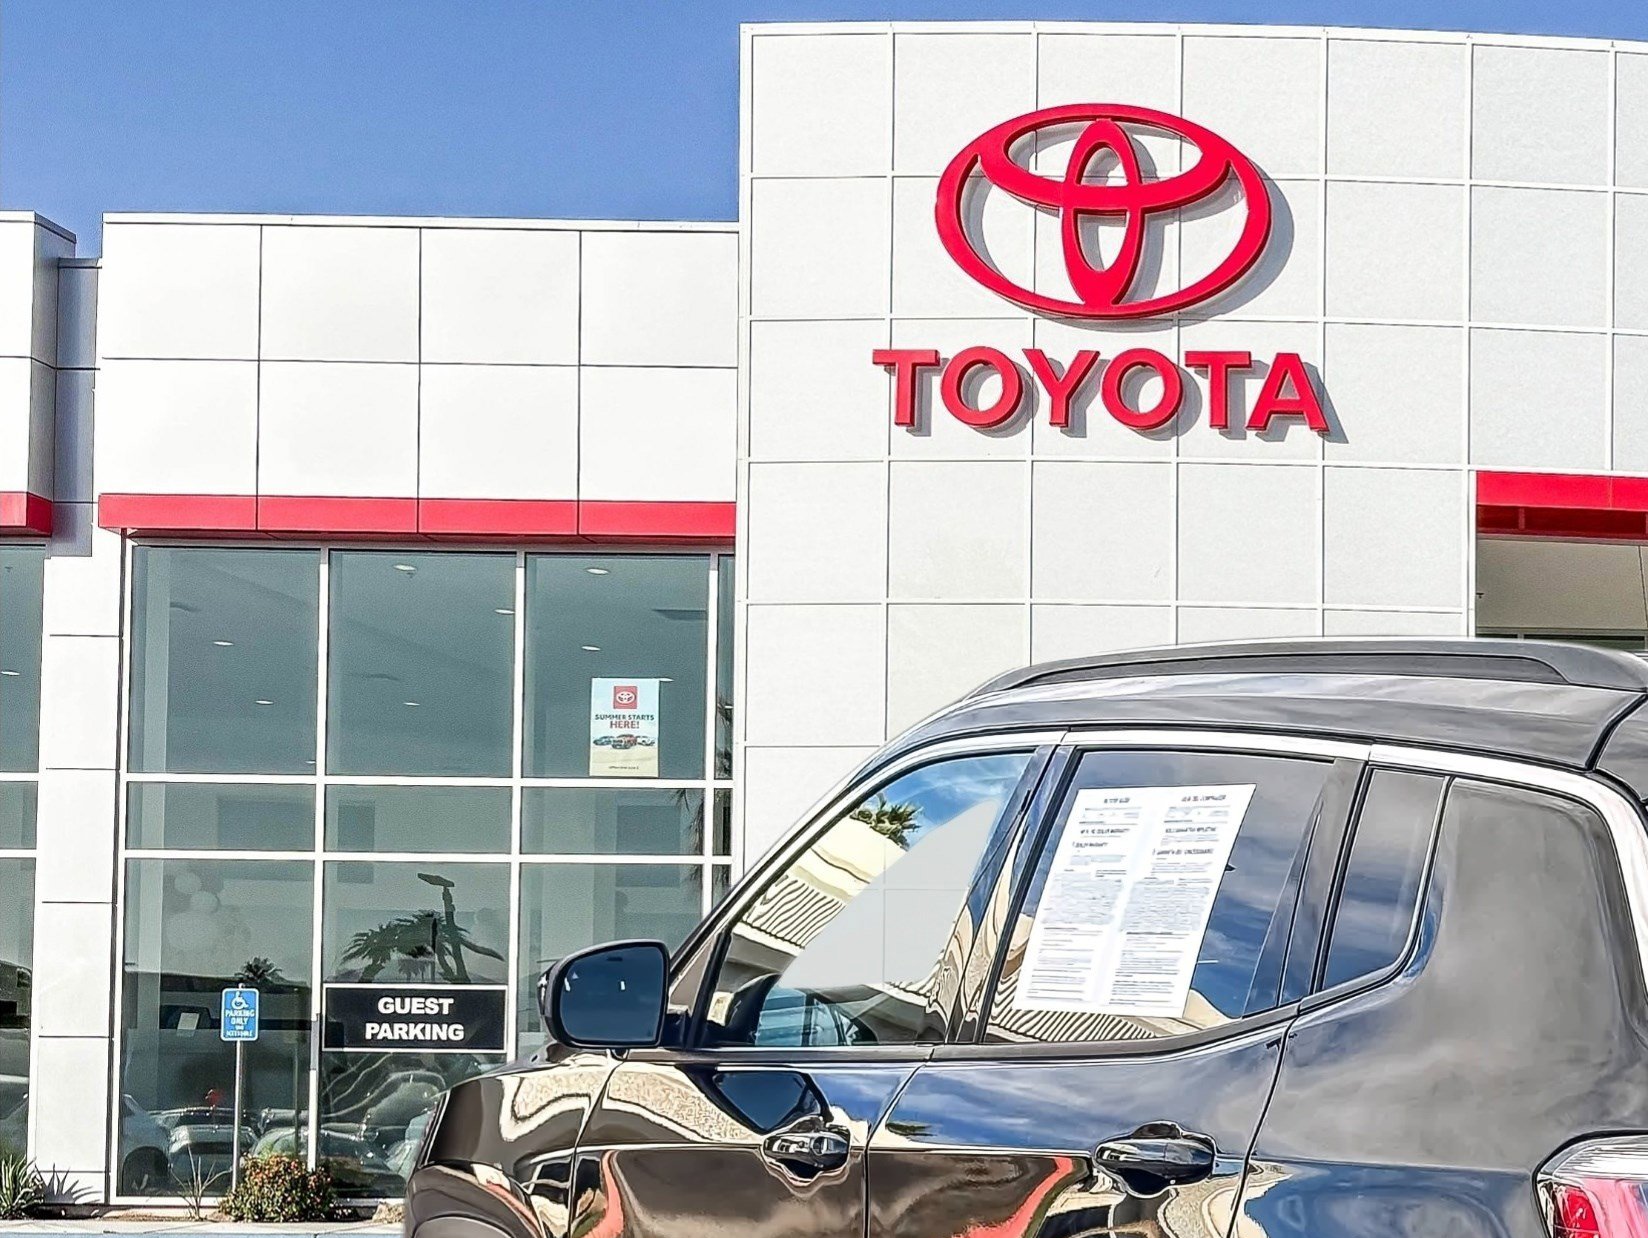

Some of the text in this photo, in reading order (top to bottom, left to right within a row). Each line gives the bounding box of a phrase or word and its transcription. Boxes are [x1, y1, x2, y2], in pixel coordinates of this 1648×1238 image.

[872, 346, 1330, 432] TOYOTA
[609, 721, 640, 729] HERE!
[225, 1009, 255, 1017] PARKING
[377, 997, 454, 1015] GUEST
[365, 1023, 464, 1041] PARKING
